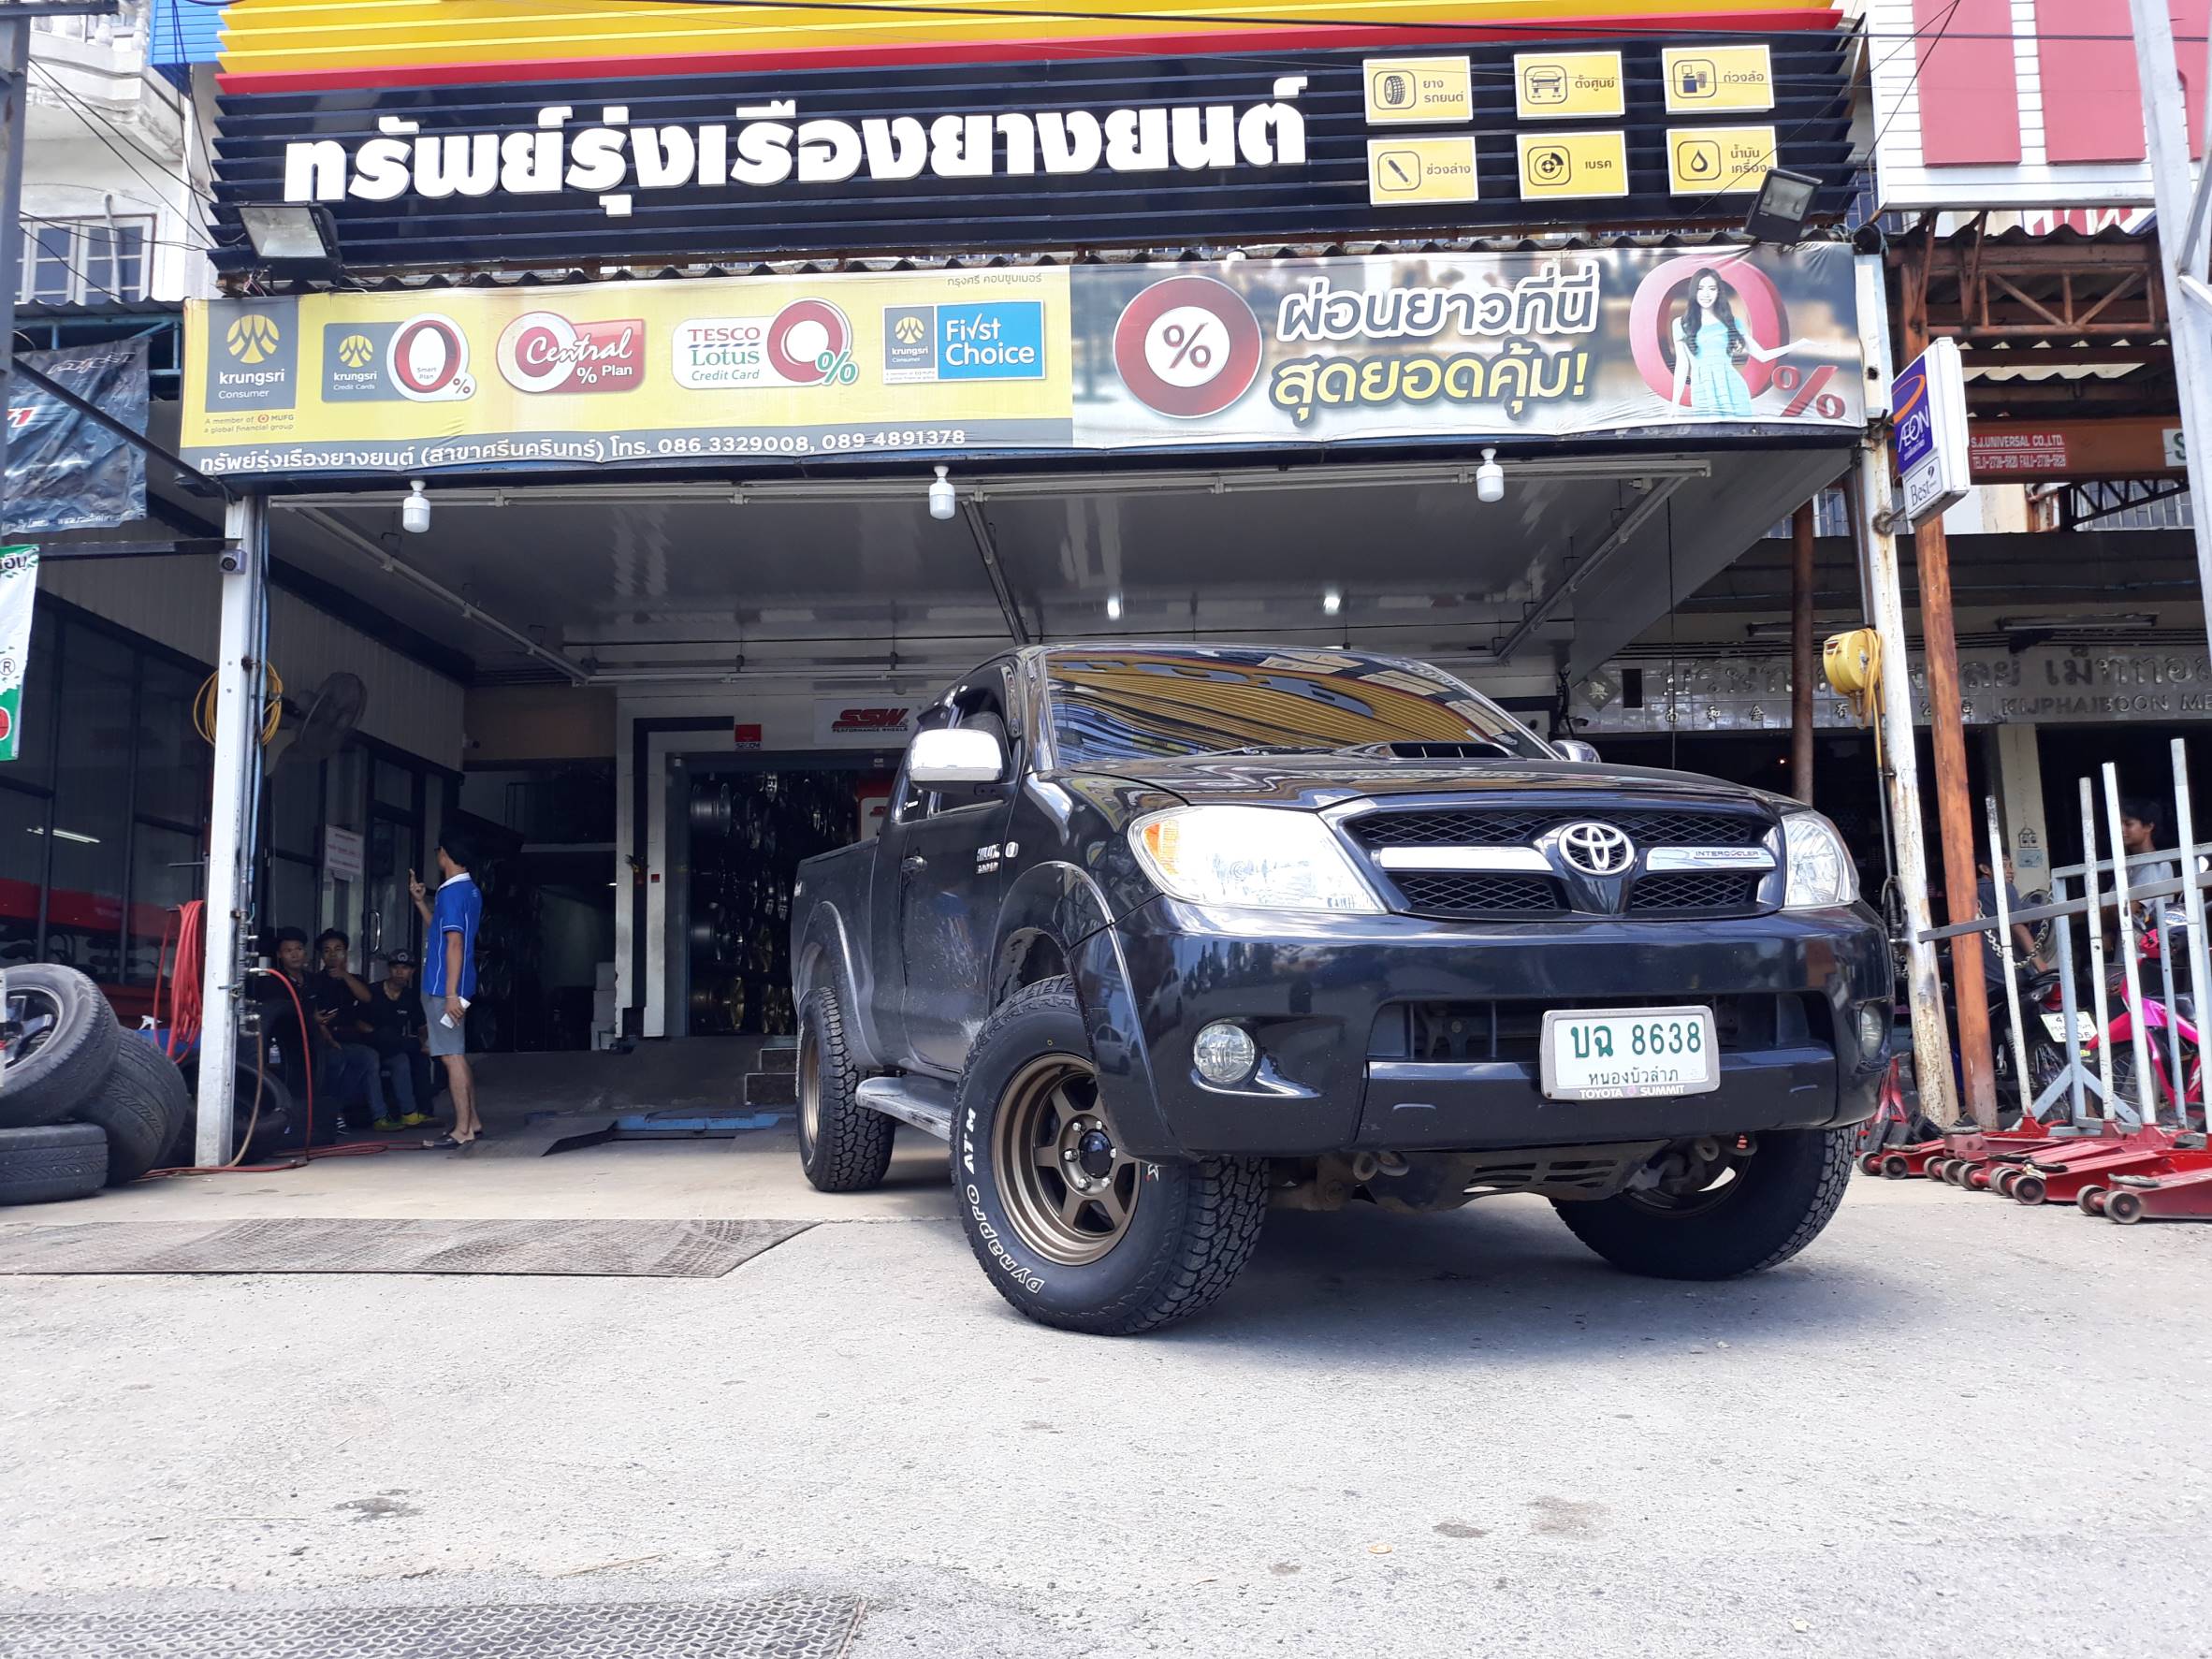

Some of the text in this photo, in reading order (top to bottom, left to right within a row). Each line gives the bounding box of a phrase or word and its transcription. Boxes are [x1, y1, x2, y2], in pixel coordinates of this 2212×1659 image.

[1724, 69, 1765, 83] ถ่วงล้อ
[1422, 79, 1444, 89] ยาง
[1575, 75, 1615, 93] ตั้งศูนย์
[1424, 91, 1464, 103] รถยนต์
[283, 76, 1309, 216] ทรัพย์รุ่งเรืองยางยนต์
[1730, 144, 1760, 158] น้ำมัน
[1426, 163, 1471, 175] ช่วงล่าง
[1585, 160, 1612, 169] เบรค
[947, 274, 981, 287] กรุงศรี
[1278, 262, 1599, 341] ผ่อนยาวที่นี่
[688, 327, 761, 342] TESCO
[526, 327, 633, 364] Central
[892, 346, 929, 357] krungsri
[691, 347, 761, 366] Lotus
[945, 343, 1035, 365] Choice
[219, 369, 284, 386] krungsri
[333, 371, 378, 381] krungsri
[602, 364, 633, 376] Plan
[691, 370, 760, 381] Credit Card
[1273, 339, 1589, 423] สุดยอดคุ้ม!
[218, 389, 269, 399] Consumer
[211, 425, 234, 434] global
[236, 423, 269, 431] financial
[270, 423, 294, 431] group
[200, 429, 966, 473] ทรัพย์รุ่งเรืองยางยนต์ (สาขาศรีนครินทร์) โทร. 086 3329008, 089 4891378
[1910, 480, 1930, 506] Best
[832, 708, 910, 727] SSW
[1570, 1021, 1701, 1058] บฉ 8638
[1588, 1066, 1679, 1085] หนองบัวลำภ
[1579, 1084, 1685, 1099] TOYOTA SUMMIT
